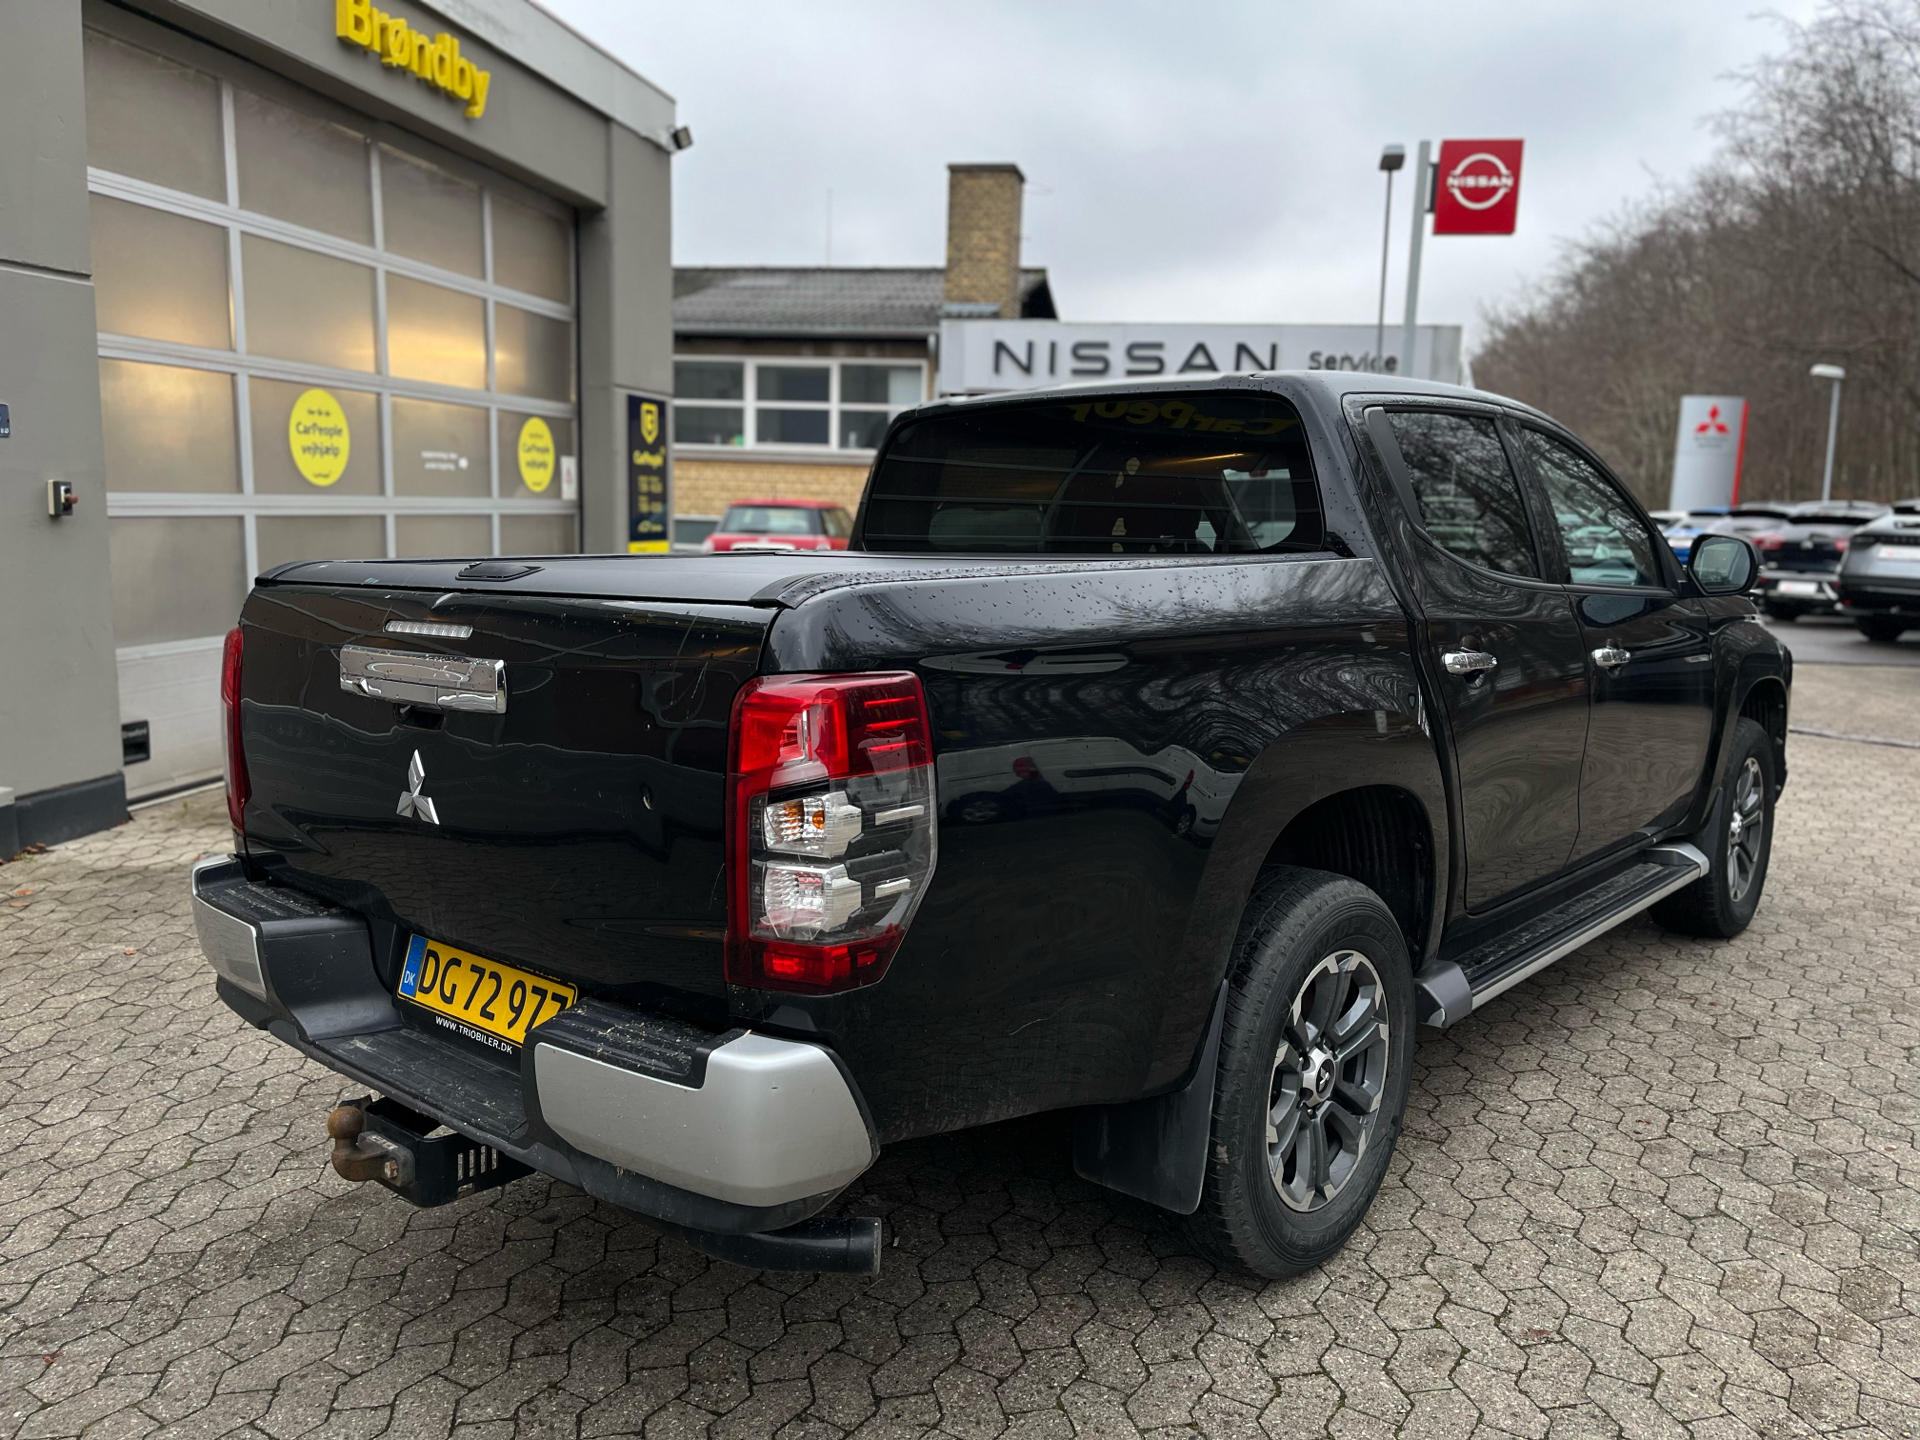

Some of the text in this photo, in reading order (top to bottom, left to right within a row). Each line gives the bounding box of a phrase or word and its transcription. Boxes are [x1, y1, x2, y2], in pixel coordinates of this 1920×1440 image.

[336, 0, 490, 118] Brøndby
[1446, 174, 1513, 189] NISSAN
[993, 340, 1398, 376] NISSAN Service
[404, 970, 415, 986] DK
[435, 1015, 513, 1055] WWW.TRIOBILER.DK
